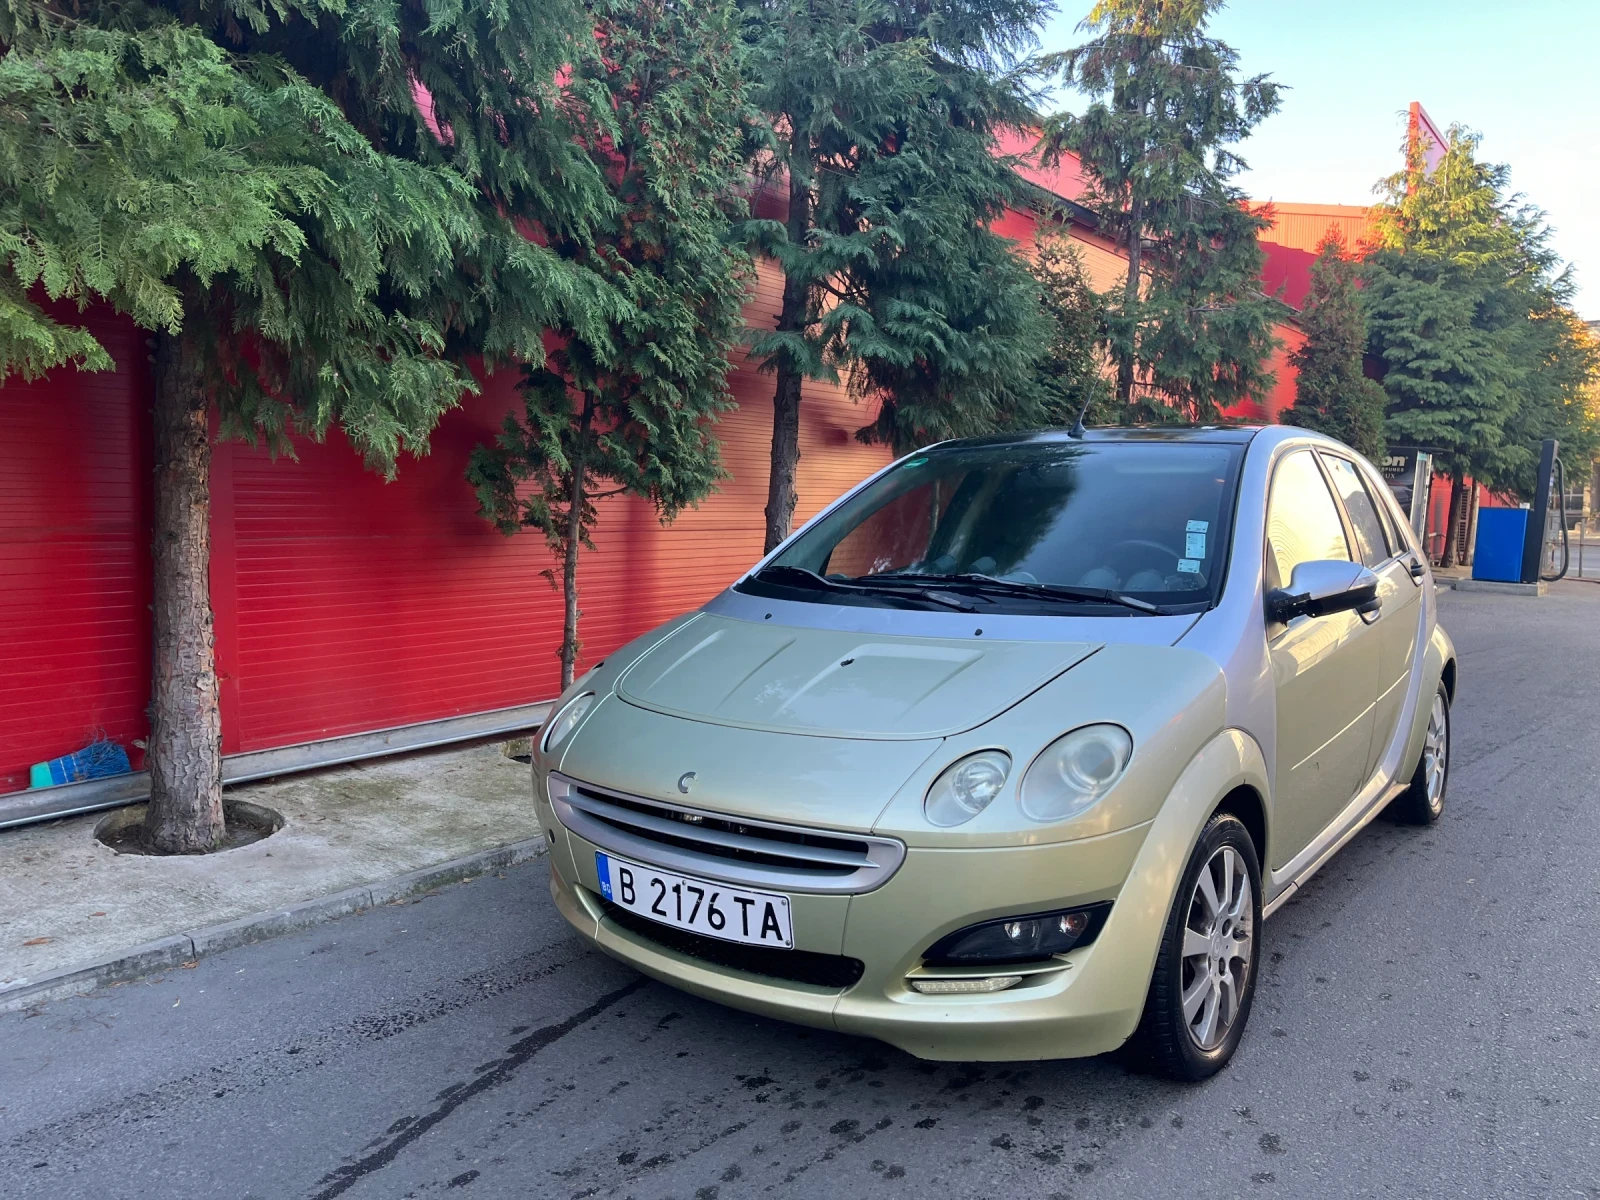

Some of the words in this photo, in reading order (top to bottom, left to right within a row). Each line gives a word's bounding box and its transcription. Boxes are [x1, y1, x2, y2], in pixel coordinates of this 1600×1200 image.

[601, 881, 611, 894] BG
[619, 867, 636, 906] B
[650, 877, 726, 931] 2176
[733, 896, 784, 941] TA
